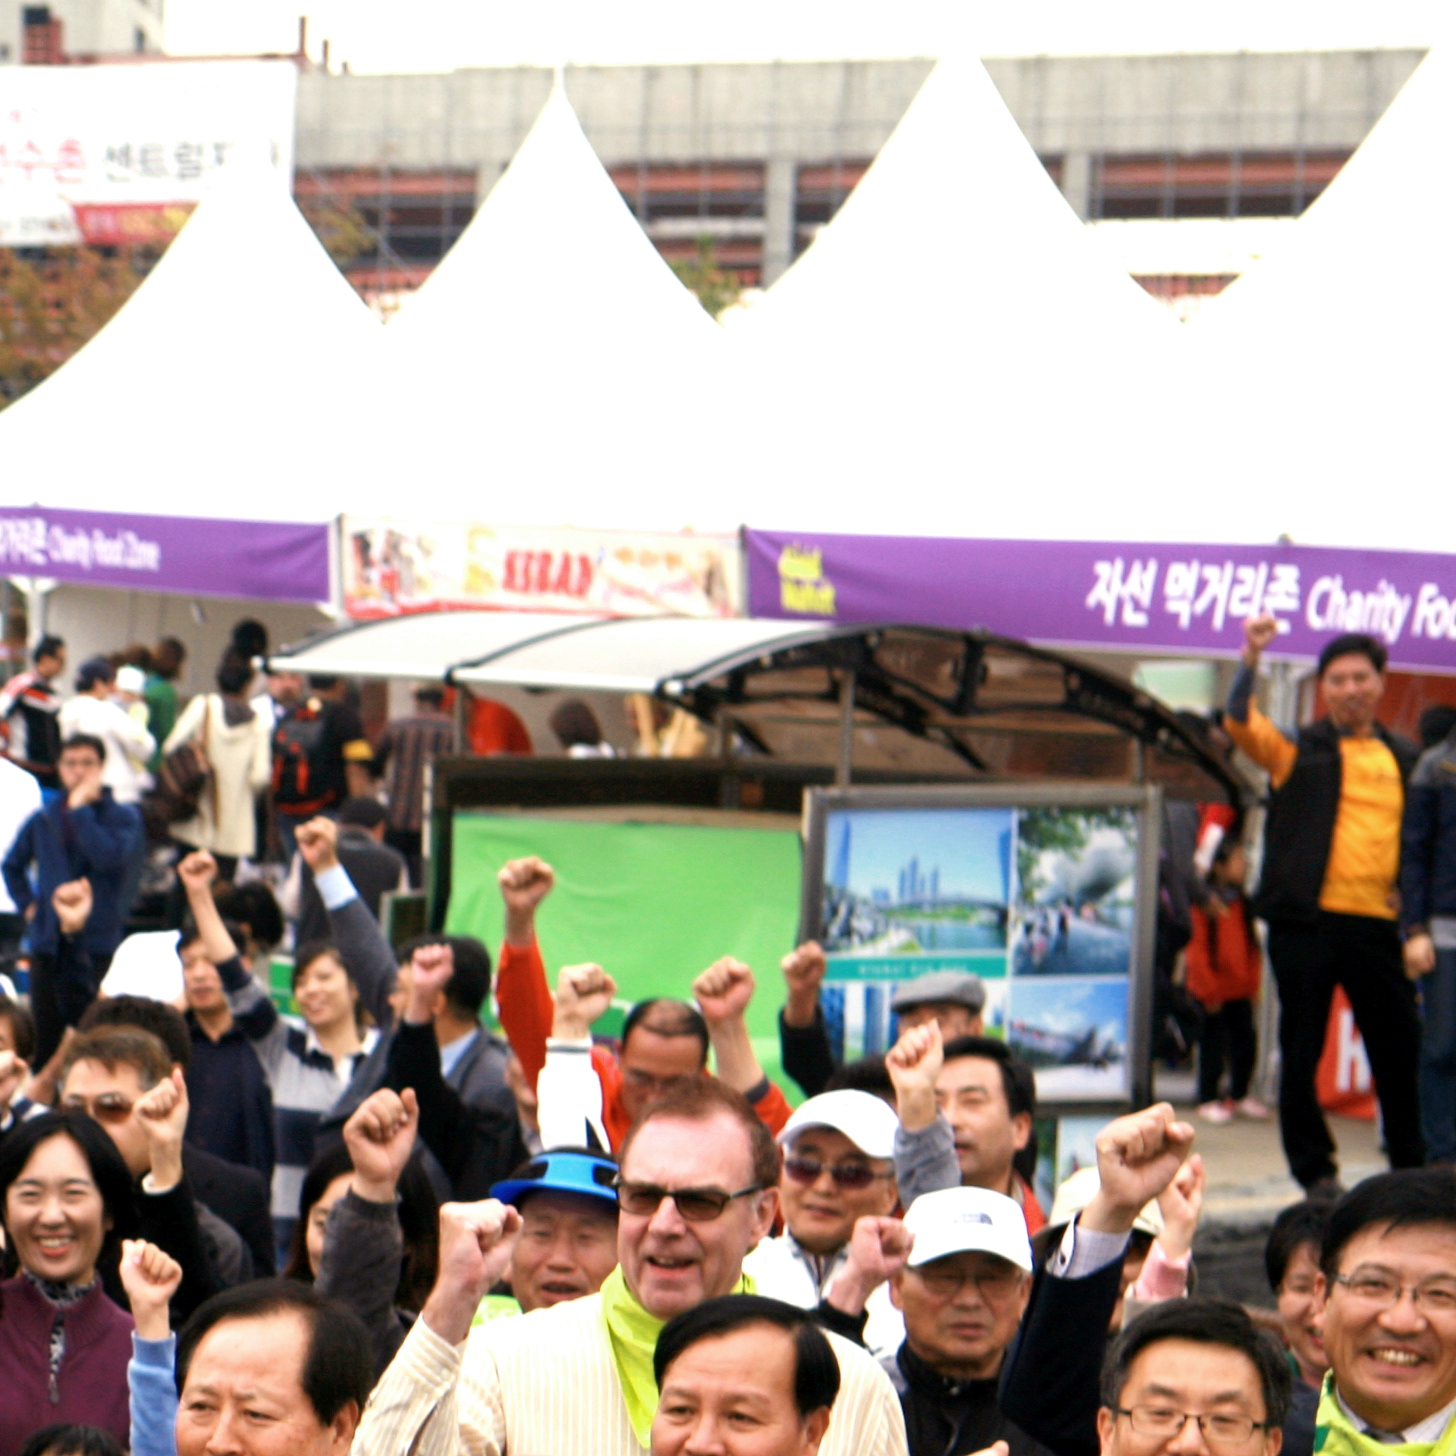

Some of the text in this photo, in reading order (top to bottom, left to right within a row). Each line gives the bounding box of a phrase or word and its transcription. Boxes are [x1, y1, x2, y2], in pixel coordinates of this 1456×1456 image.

[102, 139, 282, 183] 센트럴
[1085, 556, 1302, 636] 자선 먹거리존
[1305, 573, 1413, 645] Charity
